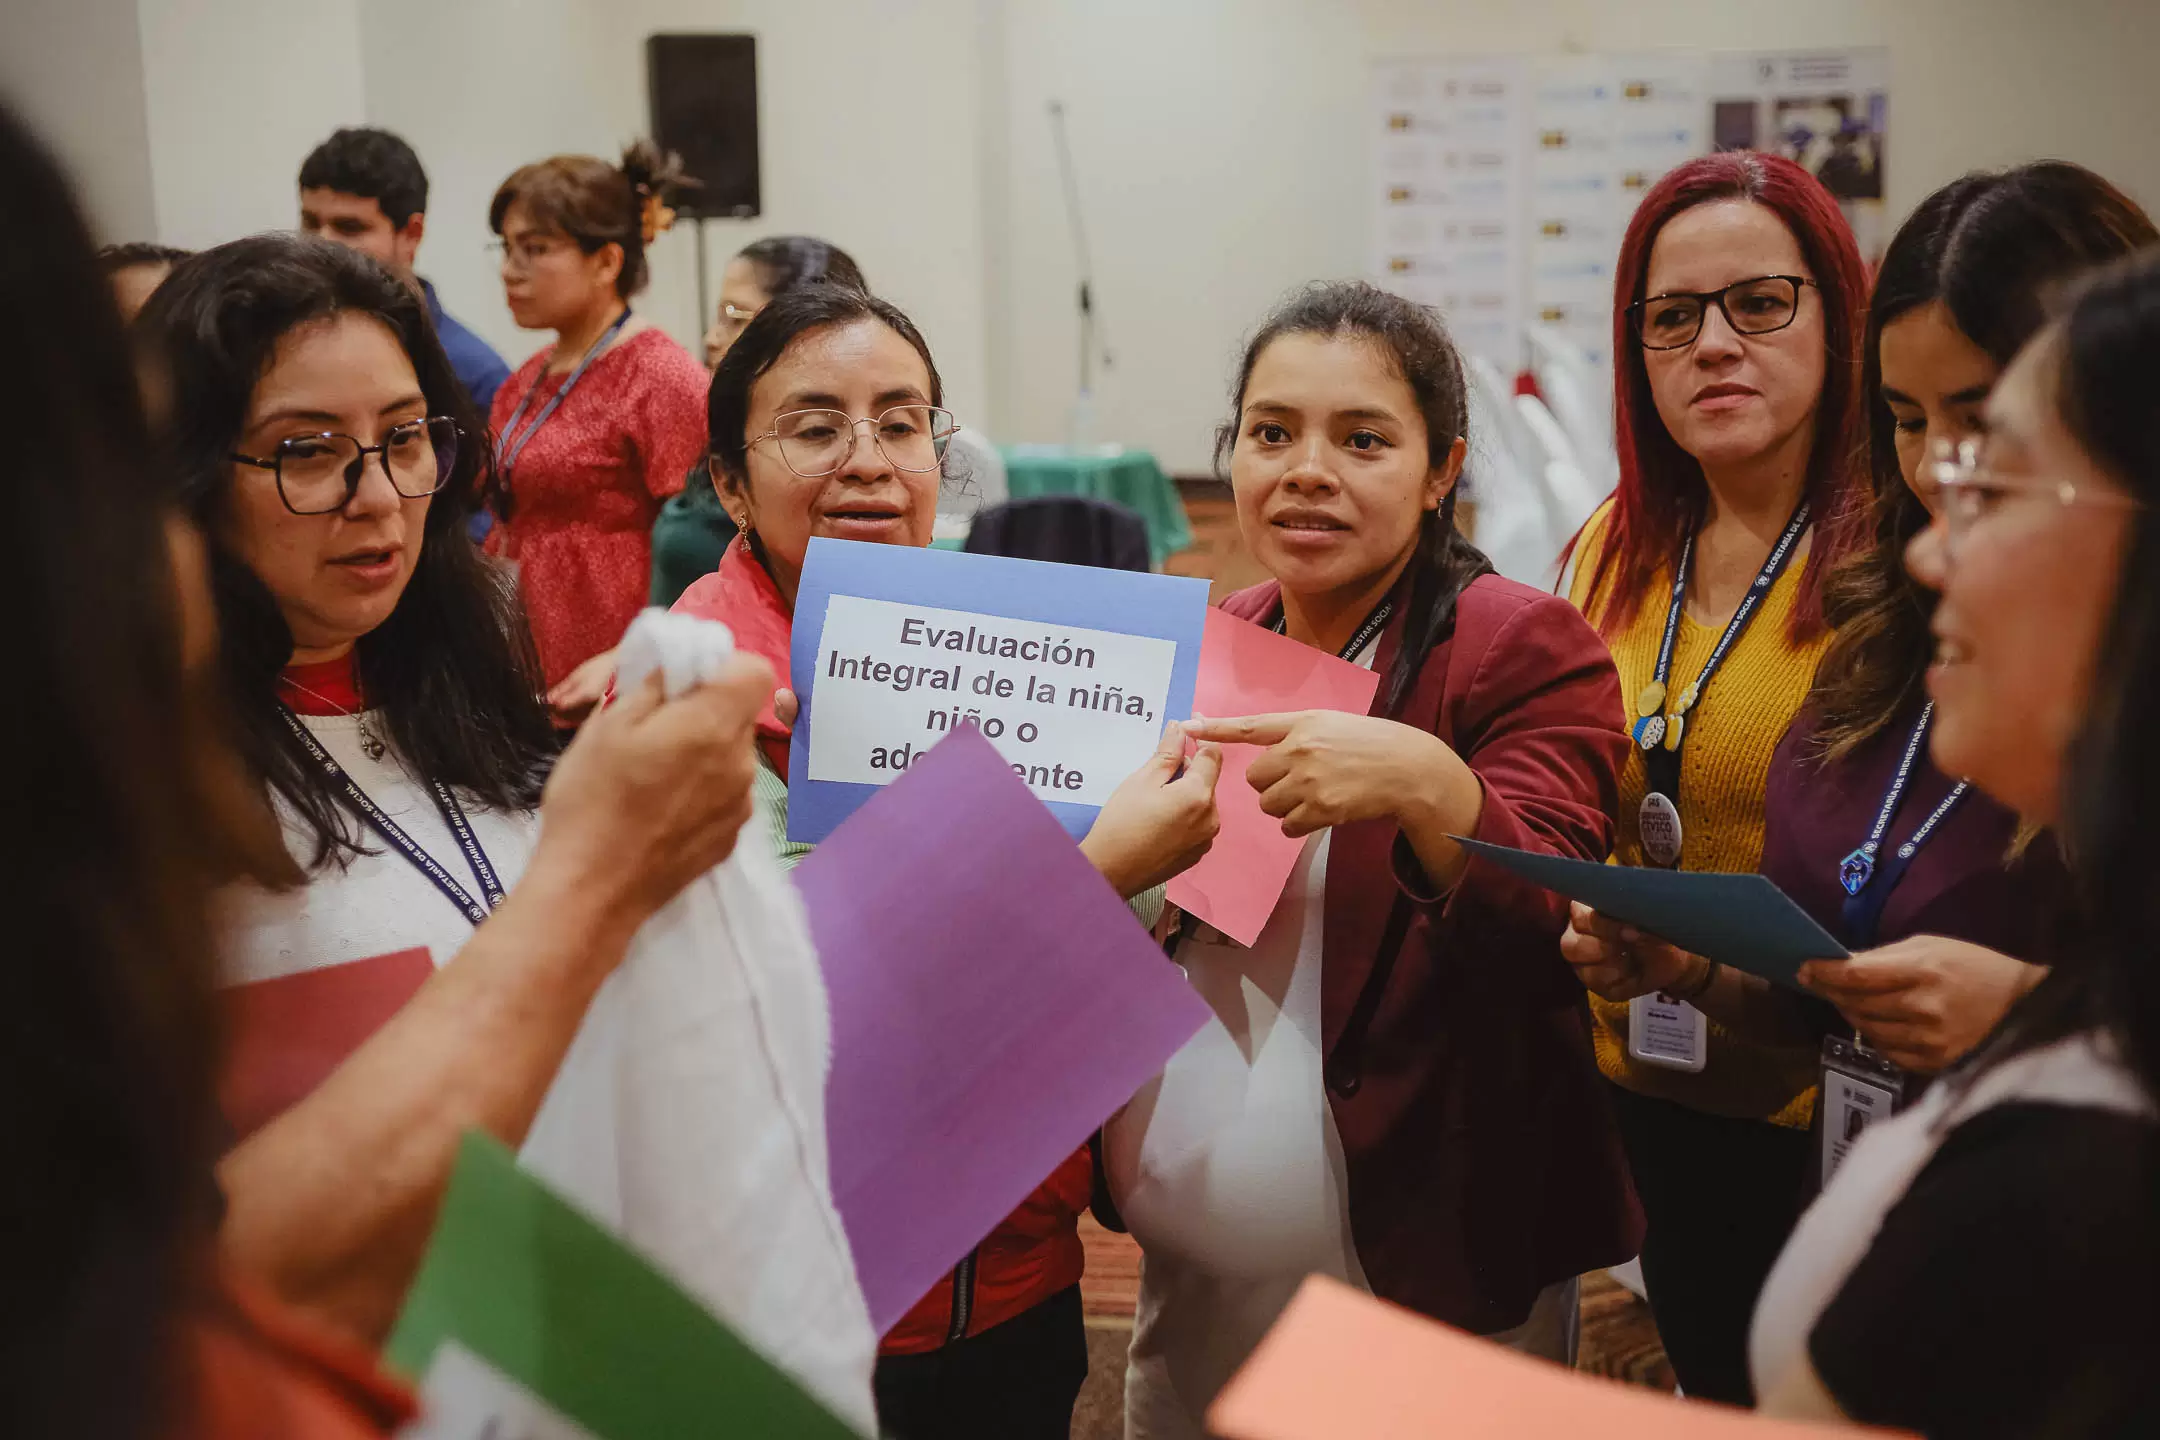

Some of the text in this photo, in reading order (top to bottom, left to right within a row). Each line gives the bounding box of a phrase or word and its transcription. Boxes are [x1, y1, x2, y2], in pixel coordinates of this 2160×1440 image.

[900, 617, 1096, 669] Evaluación
[1714, 619, 1741, 658] BIENESTAR
[1736, 594, 1757, 621] SOCIAL
[828, 650, 1154, 722] Integral de la niña,
[926, 705, 1039, 743] niño o
[1898, 730, 1923, 777] BIENESTAR
[1892, 777, 1905, 789] DE
[458, 827, 471, 840] DE
[1912, 781, 1967, 843] SECRETARÍA DE
[345, 783, 471, 905] SECRETARÍA DE BIENESTAR SOCIAL
[464, 839, 497, 890] SECRETARÍA
